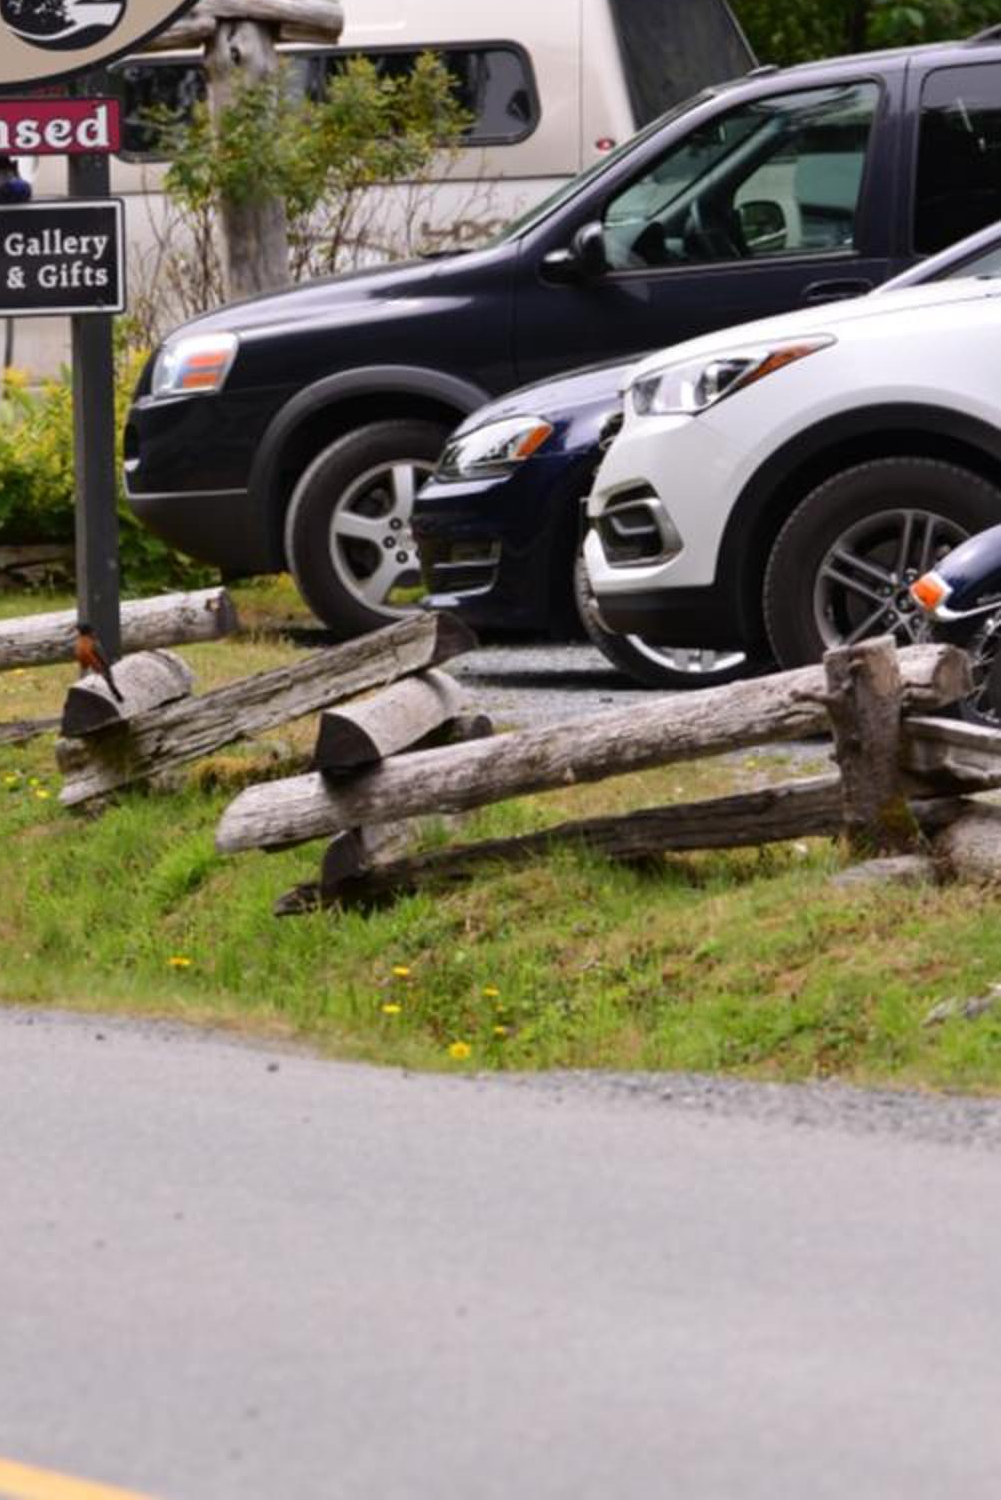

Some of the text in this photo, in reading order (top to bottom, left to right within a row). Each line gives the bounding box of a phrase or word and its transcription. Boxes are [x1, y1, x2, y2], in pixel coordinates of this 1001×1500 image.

[4, 228, 109, 260] Gallery
[6, 261, 109, 289] & Gifts
